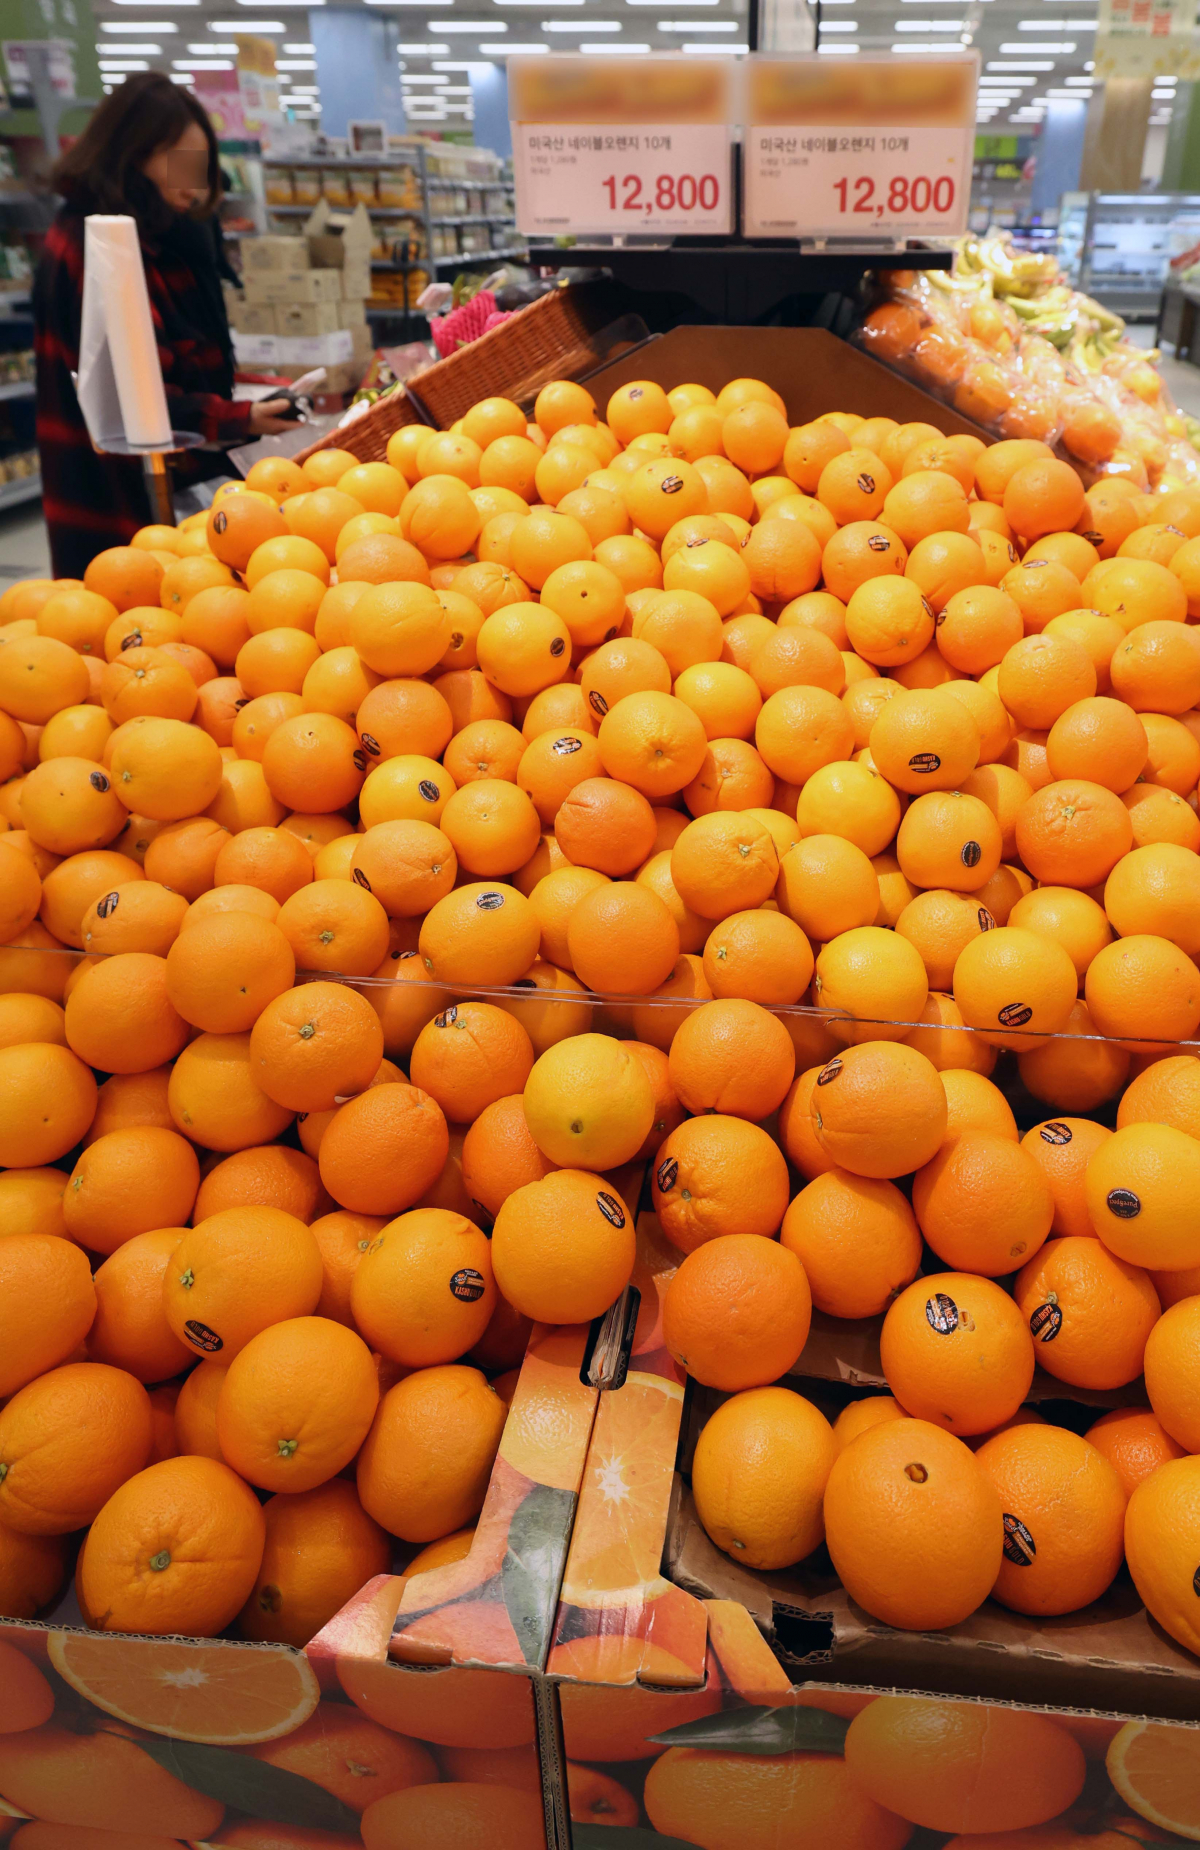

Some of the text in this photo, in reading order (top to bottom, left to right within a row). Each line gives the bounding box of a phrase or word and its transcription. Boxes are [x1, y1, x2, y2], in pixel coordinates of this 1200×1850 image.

[529, 136, 672, 151] 미국산 네이블오렌지 10개
[760, 137, 909, 152] 미국산 네이블오렌지 10개
[602, 174, 720, 216] 12,800
[833, 175, 955, 218] 12,800
